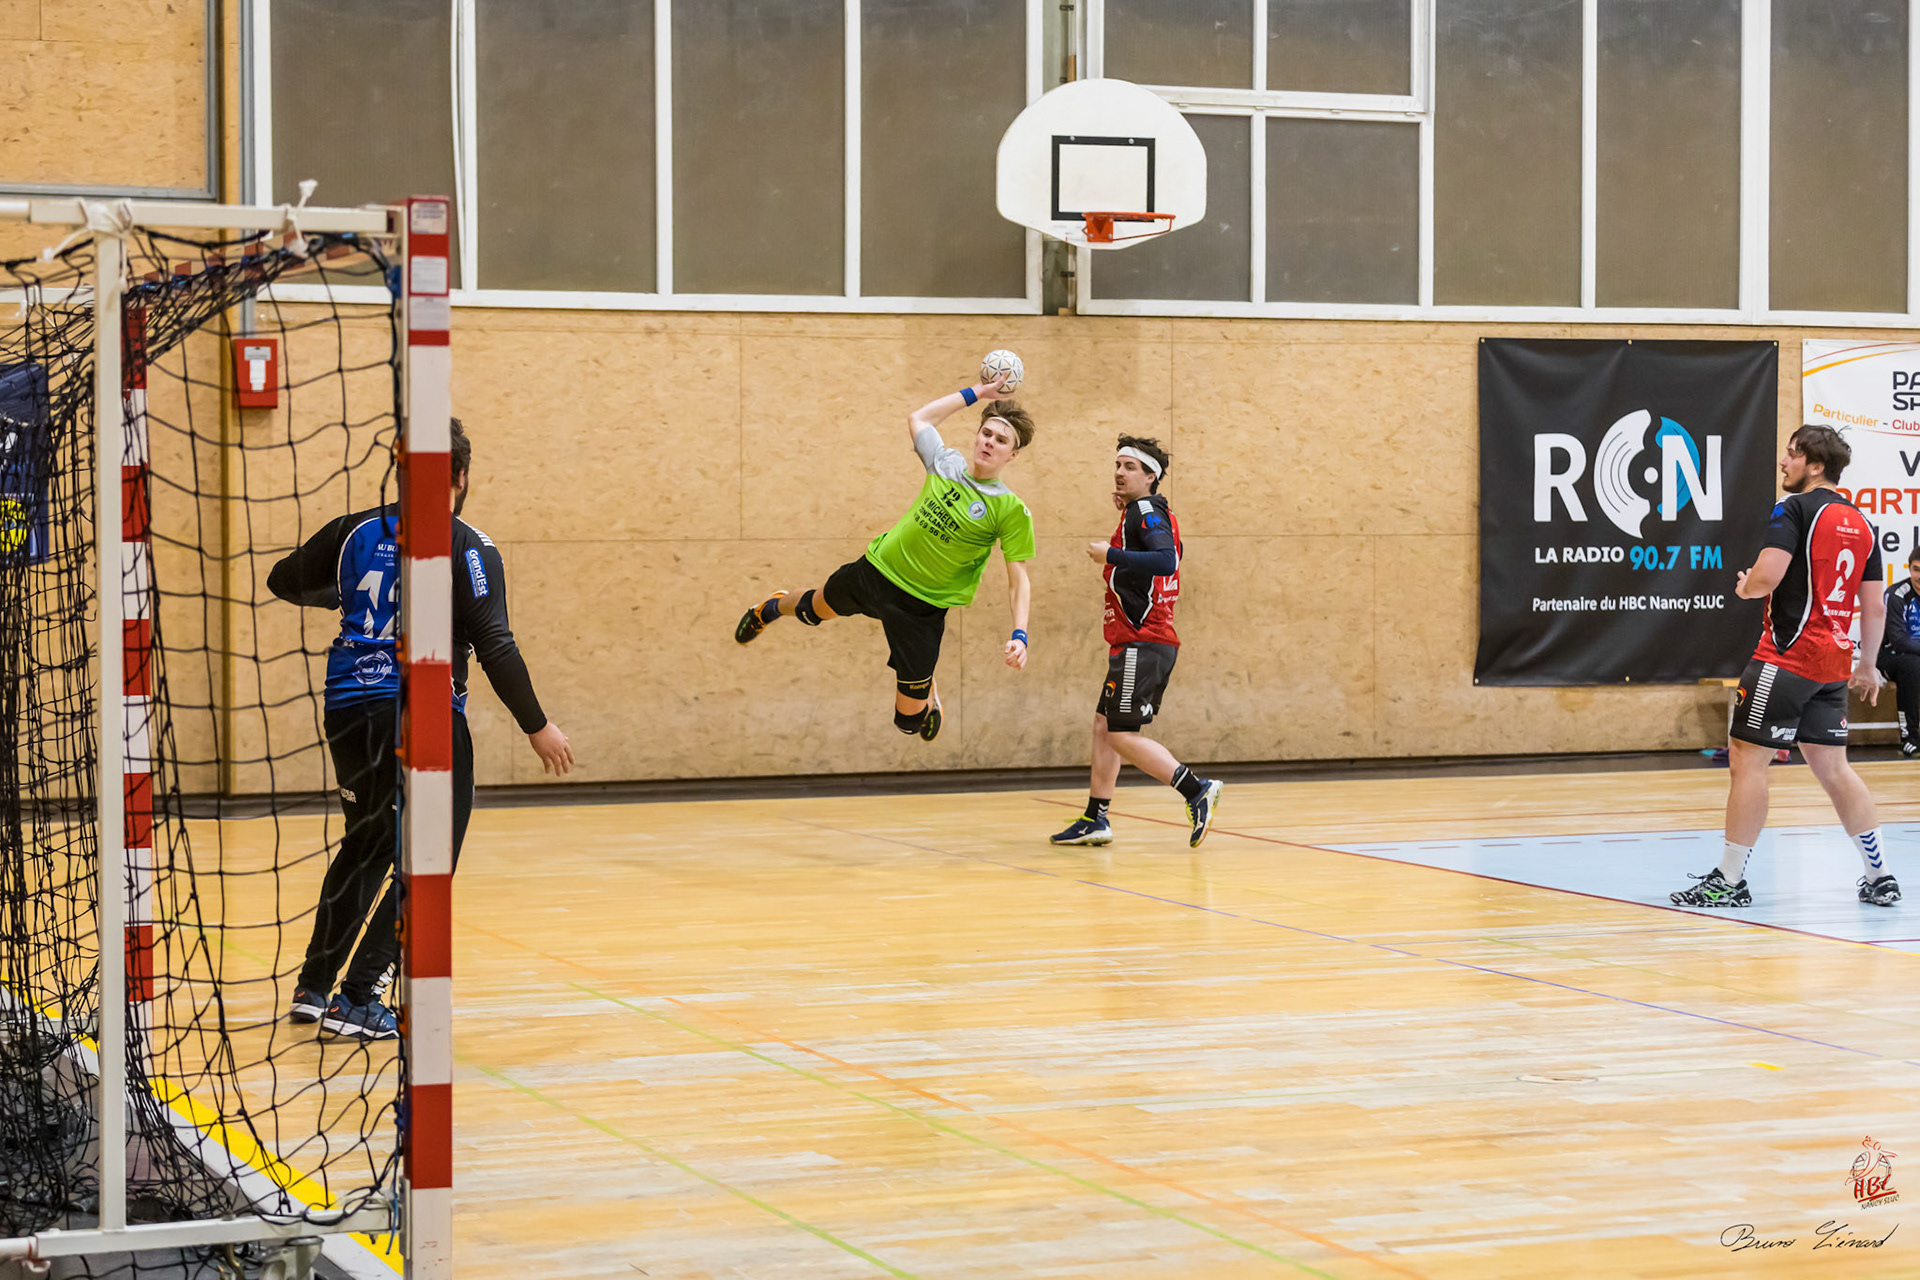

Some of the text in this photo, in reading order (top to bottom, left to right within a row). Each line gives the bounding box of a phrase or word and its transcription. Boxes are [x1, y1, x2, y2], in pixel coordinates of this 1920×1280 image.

[1813, 403, 1879, 427] Particulier
[927, 500, 960, 532] MICHELET
[1535, 545, 1723, 570] LA RADIO 90.7 FM
[1826, 549, 1855, 602] 2
[1532, 594, 1725, 613] Partenaire du HBC Nancy SLUC
